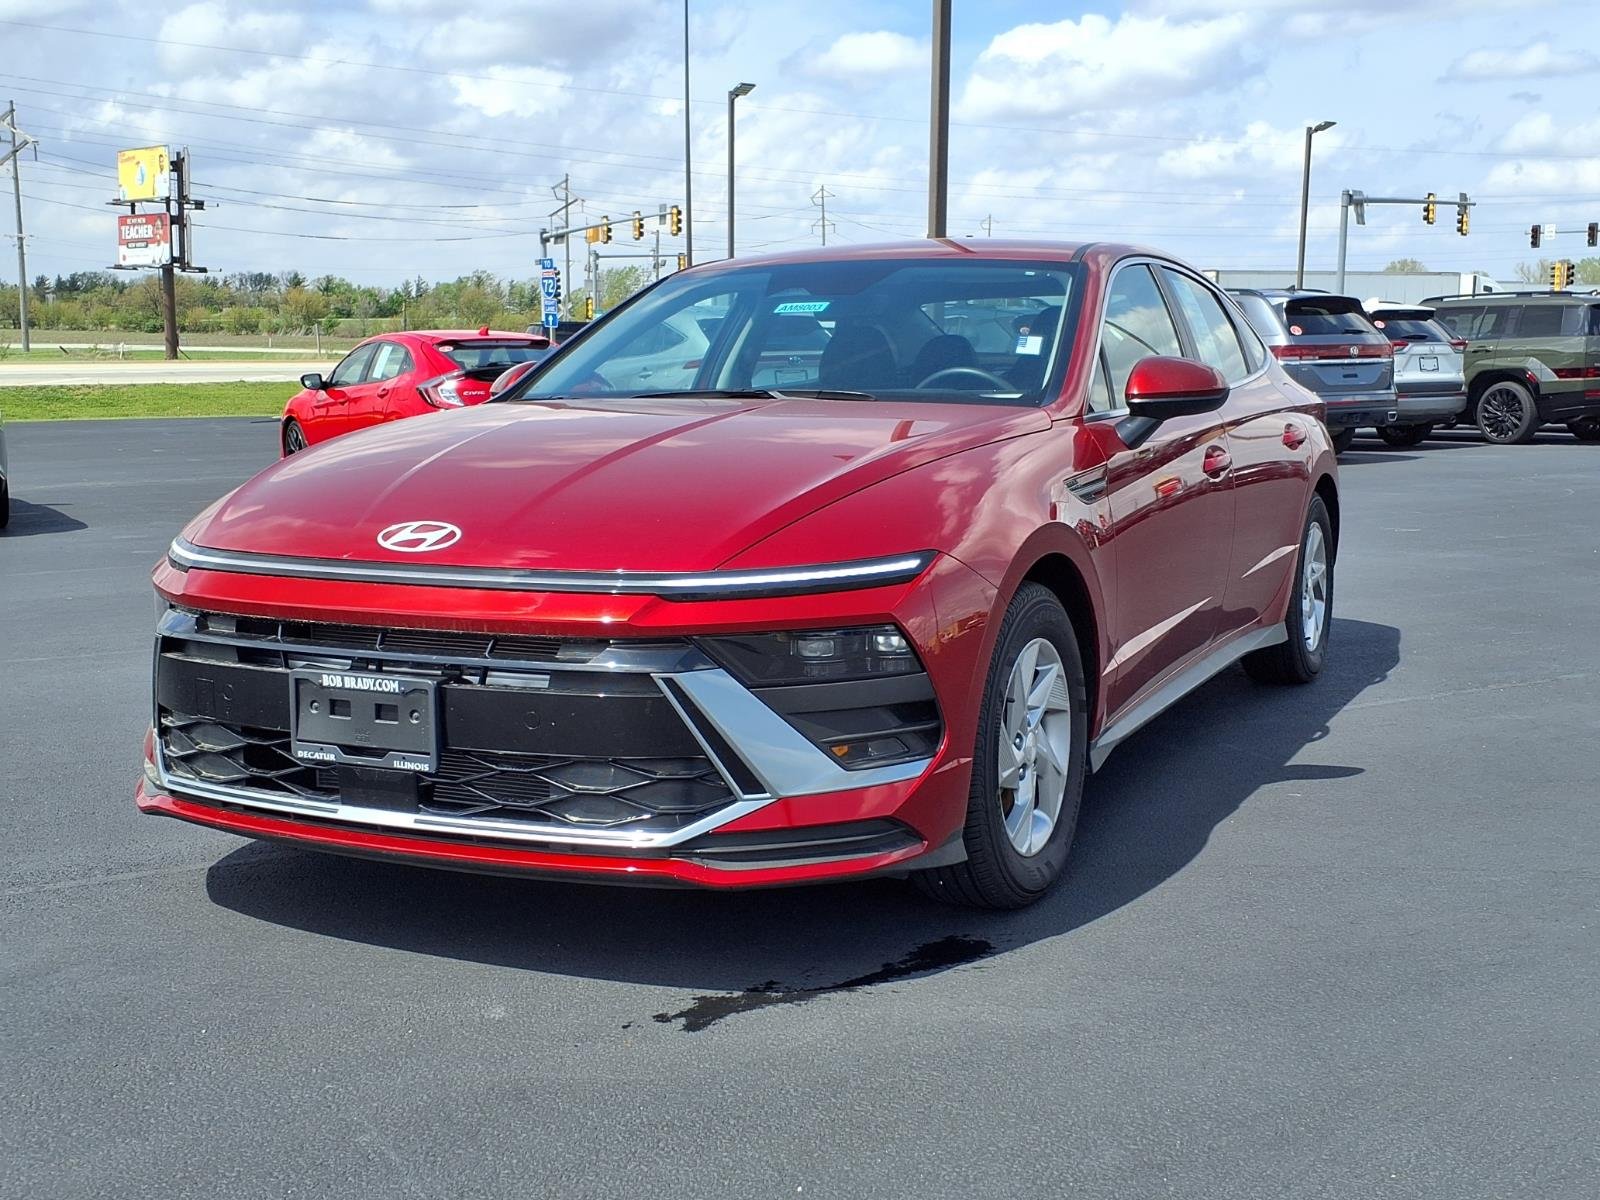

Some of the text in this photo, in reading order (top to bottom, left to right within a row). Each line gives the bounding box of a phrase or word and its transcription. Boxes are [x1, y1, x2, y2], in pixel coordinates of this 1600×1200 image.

[121, 224, 153, 239] TEACHER
[544, 260, 551, 268] TO
[543, 279, 554, 293] 72
[322, 673, 399, 692] BOB BRADY.COM
[297, 750, 336, 761] DECATUR
[394, 760, 430, 771] ILLINOIS
